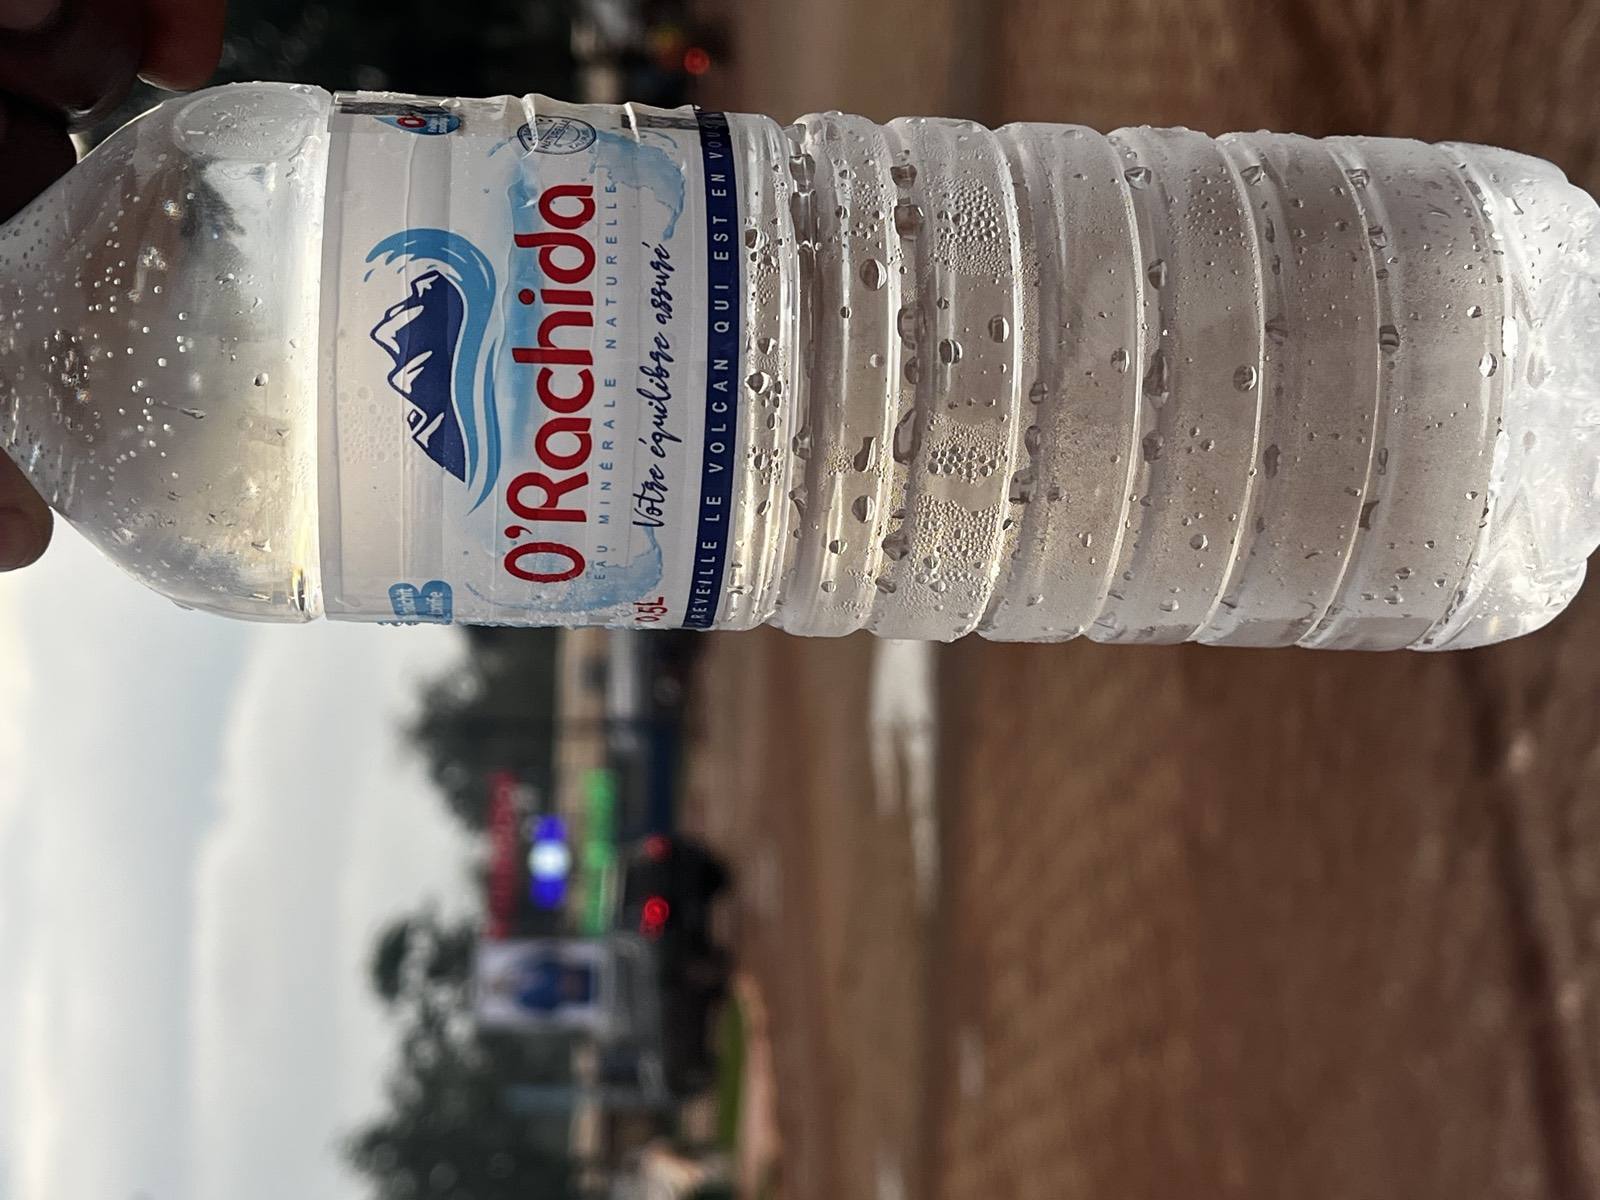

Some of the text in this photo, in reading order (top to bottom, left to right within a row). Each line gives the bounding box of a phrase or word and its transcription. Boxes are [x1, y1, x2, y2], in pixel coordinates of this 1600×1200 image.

[711, 174, 726, 196] EN
[713, 216, 729, 260] EST
[714, 285, 729, 333] QUI
[504, 185, 596, 583] O'Rachida
[595, 185, 618, 580] EAU MINÉRALE NATURELLE
[633, 241, 682, 527] Votre équilibre assuré
[709, 359, 728, 473] VOLCAN
[705, 496, 721, 521] LE
